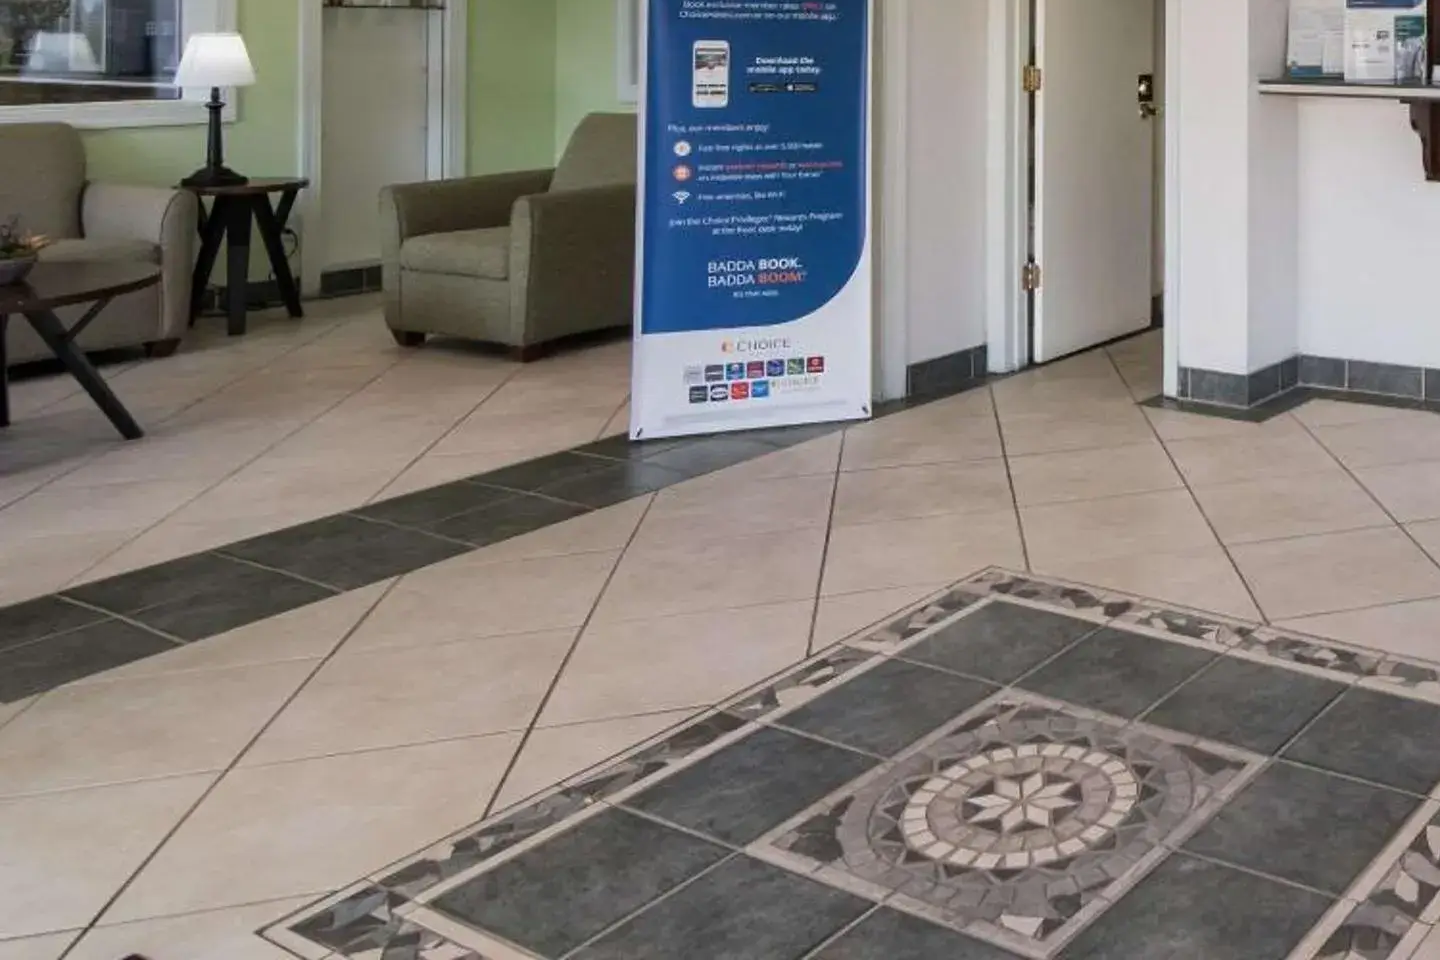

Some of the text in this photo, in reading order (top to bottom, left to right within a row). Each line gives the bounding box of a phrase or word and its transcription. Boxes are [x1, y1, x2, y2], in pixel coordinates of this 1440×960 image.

[707, 256, 803, 274] BADDA BOOK.
[707, 273, 756, 288] BADDA
[736, 337, 792, 353] CHOICE
